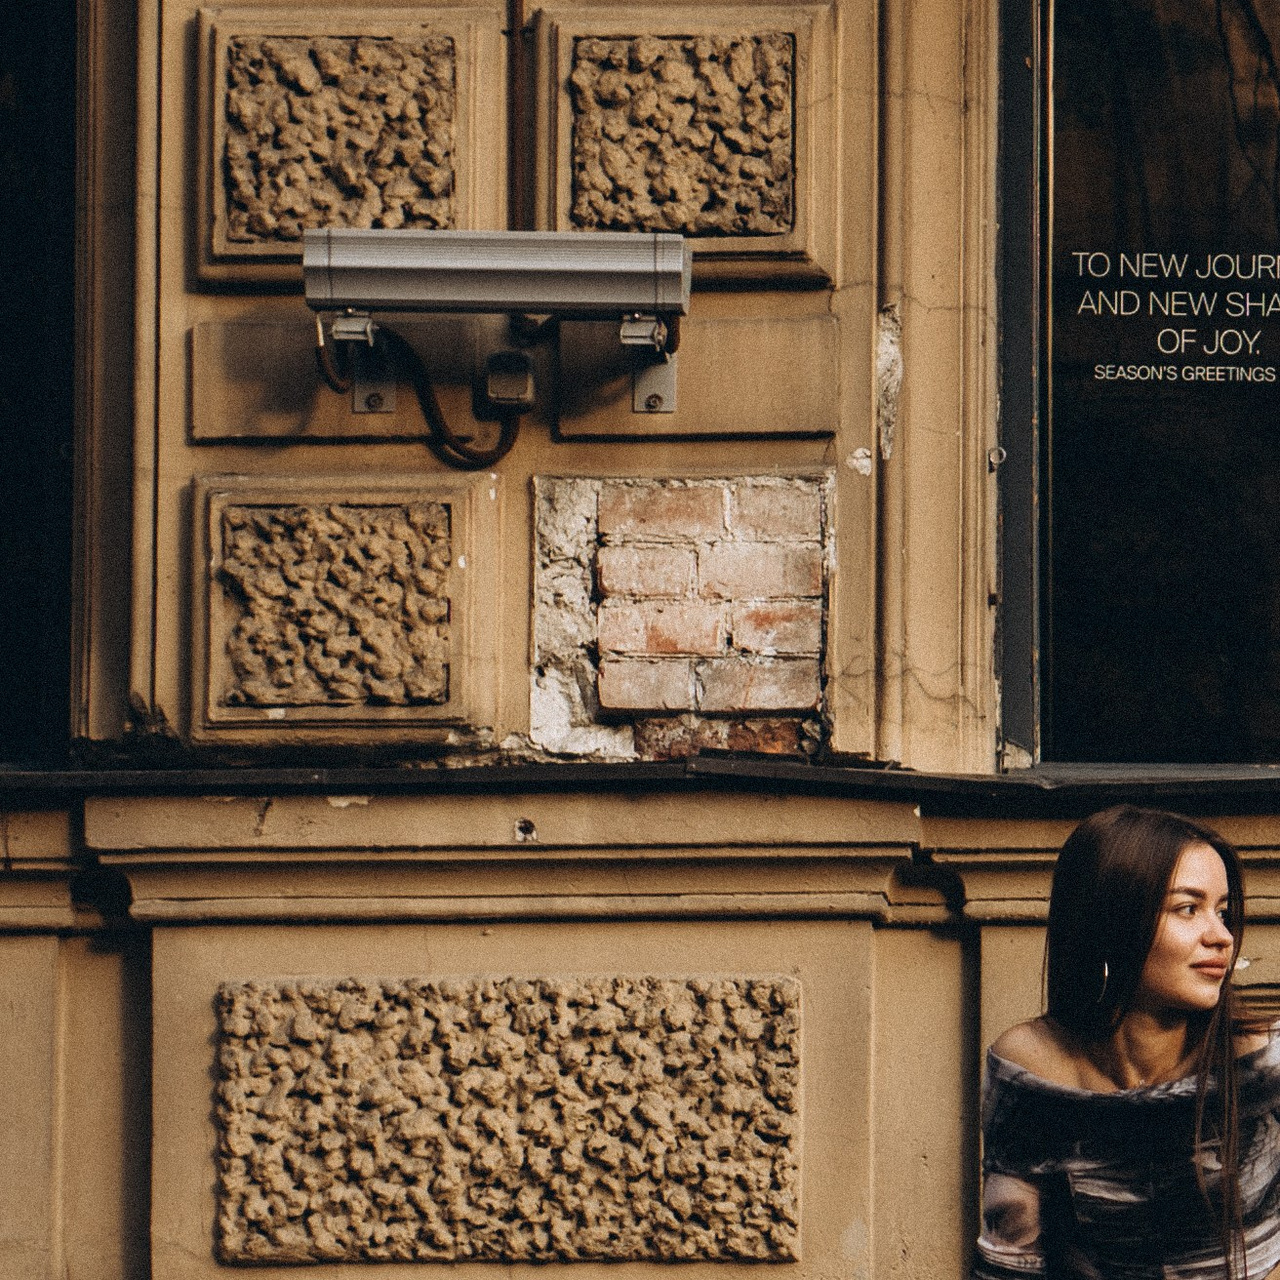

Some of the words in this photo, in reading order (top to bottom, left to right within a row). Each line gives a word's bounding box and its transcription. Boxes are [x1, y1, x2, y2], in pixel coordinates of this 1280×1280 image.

[1072, 252, 1110, 277] TO
[1119, 253, 1189, 279] NEW
[1077, 290, 1141, 316] AND
[1149, 291, 1218, 317] NEW
[1157, 328, 1198, 355] OF
[1203, 329, 1263, 356] JOY.
[1094, 364, 1178, 382] SEASON'S
[1181, 365, 1277, 383] GREETINGS
